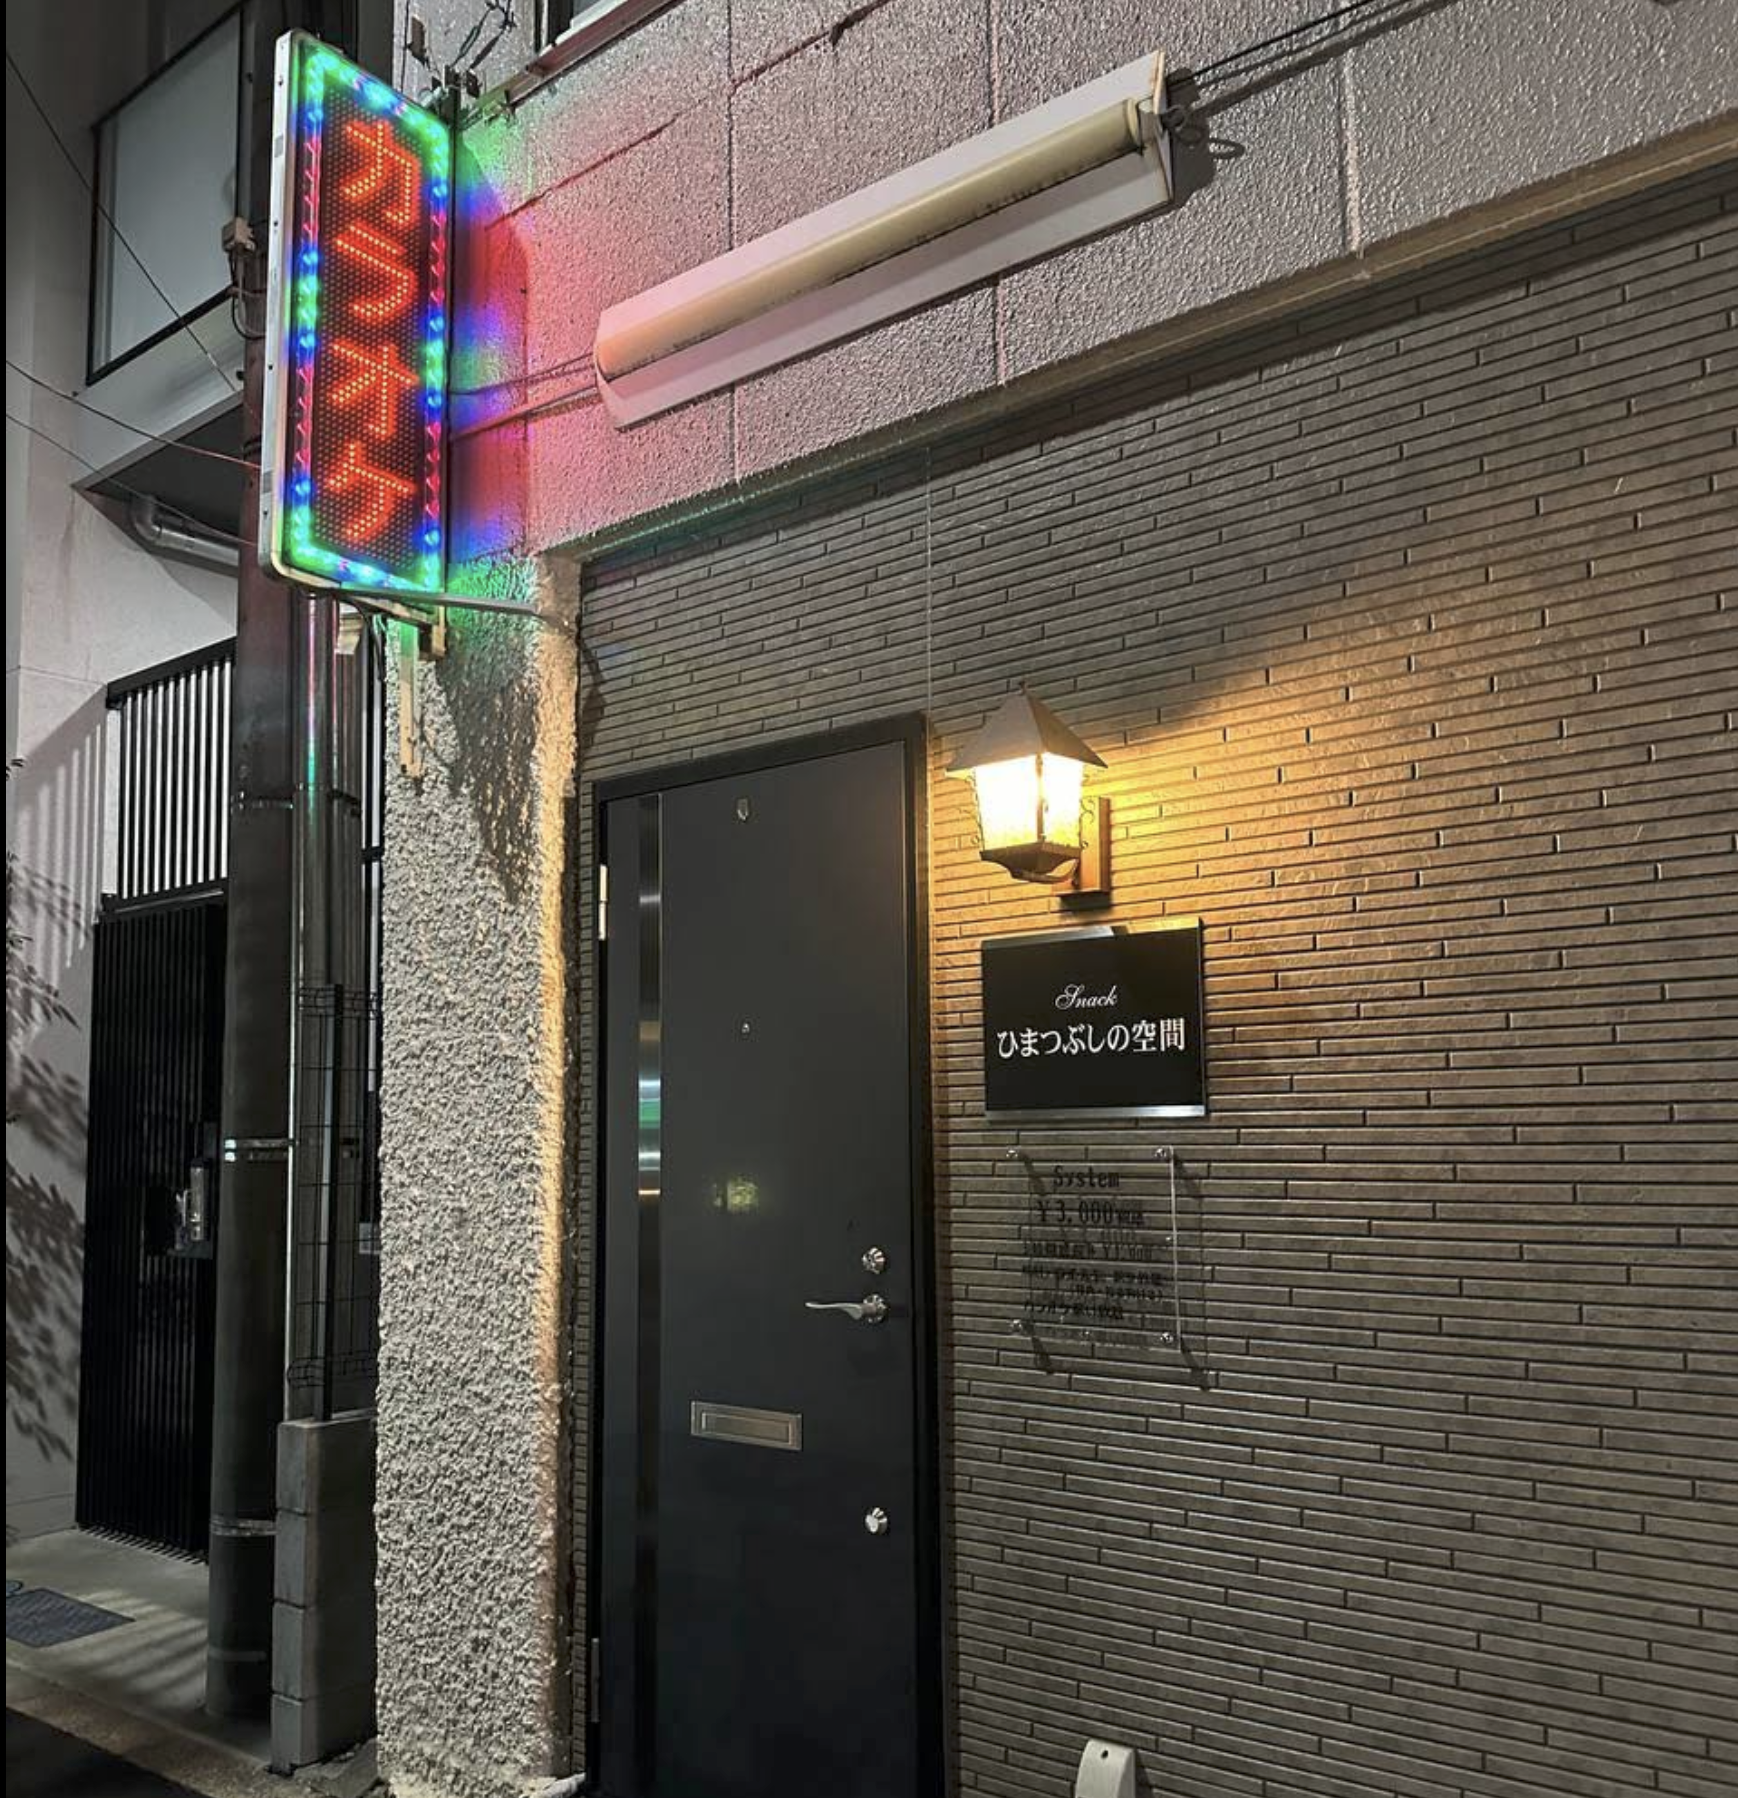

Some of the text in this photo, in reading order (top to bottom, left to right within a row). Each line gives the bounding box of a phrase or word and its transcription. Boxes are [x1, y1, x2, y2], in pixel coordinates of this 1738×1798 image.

[327, 119, 420, 542] カラオケ
[1054, 984, 1118, 1010] Snack
[996, 1017, 1187, 1059] ひまつぶしの空間
[1053, 1165, 1120, 1188] System
